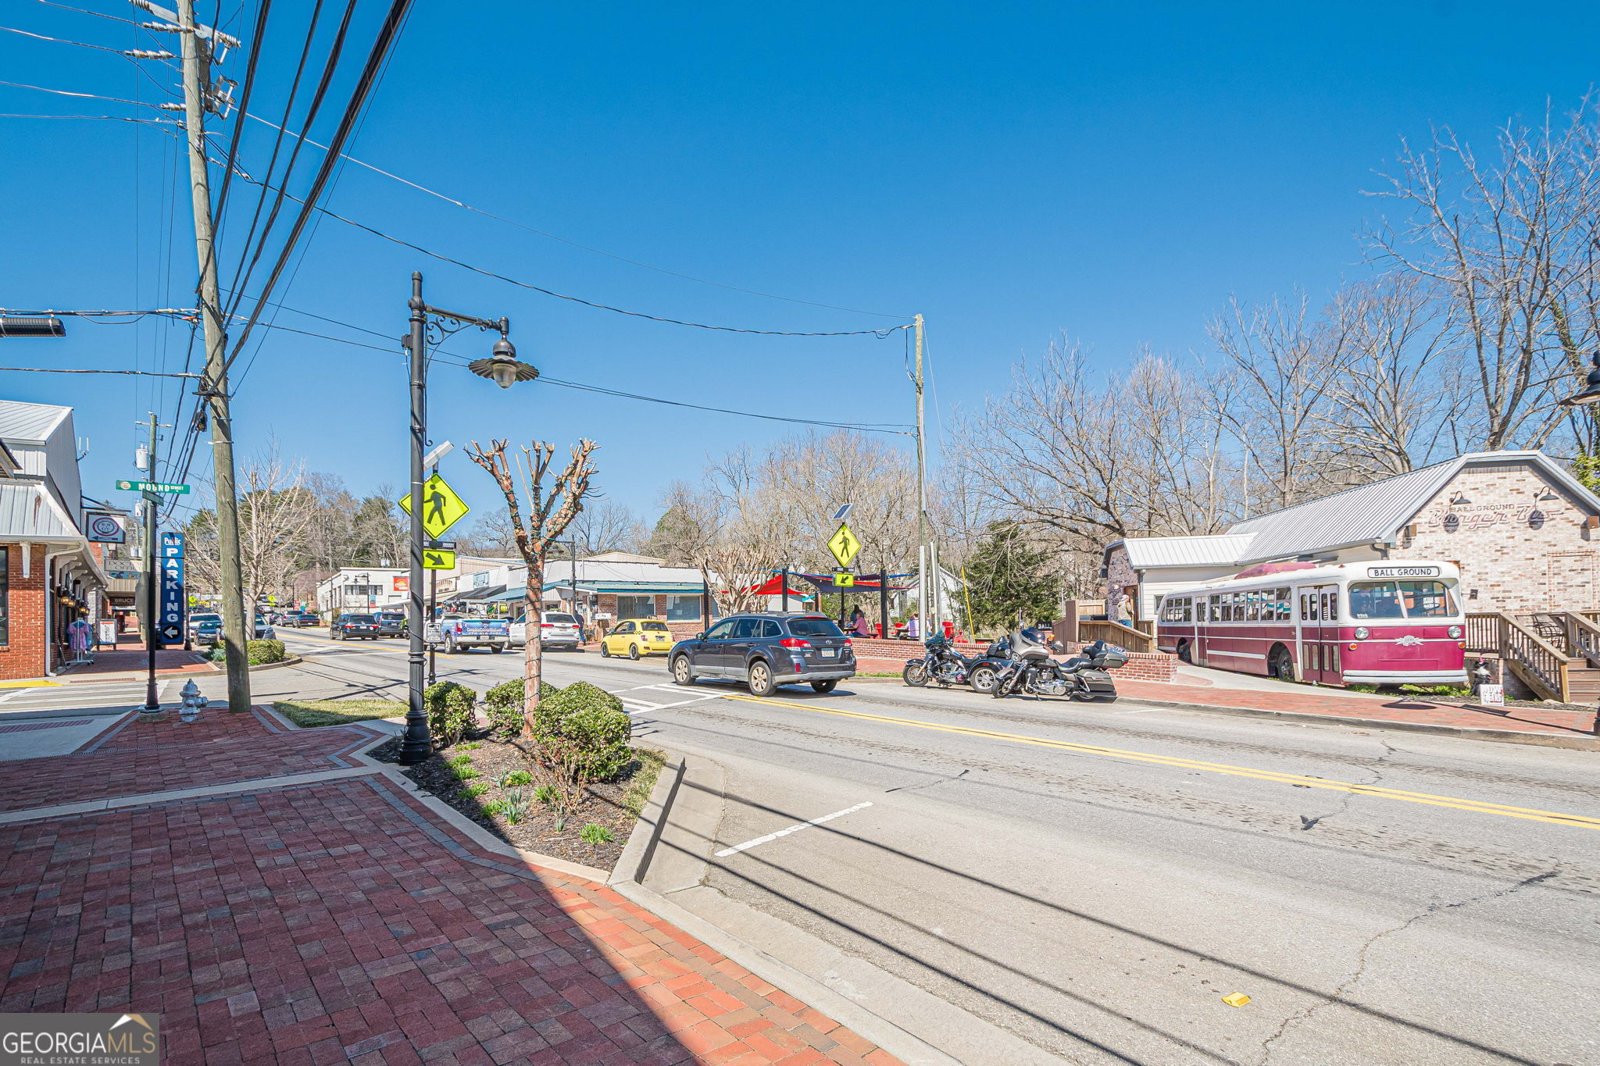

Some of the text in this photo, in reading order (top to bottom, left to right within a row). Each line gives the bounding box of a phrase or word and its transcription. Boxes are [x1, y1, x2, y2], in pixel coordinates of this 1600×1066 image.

[138, 483, 170, 492] MOUND
[1477, 504, 1515, 512] GROUND
[1397, 568, 1432, 576] GROUND
[166, 548, 178, 622] PARKING
